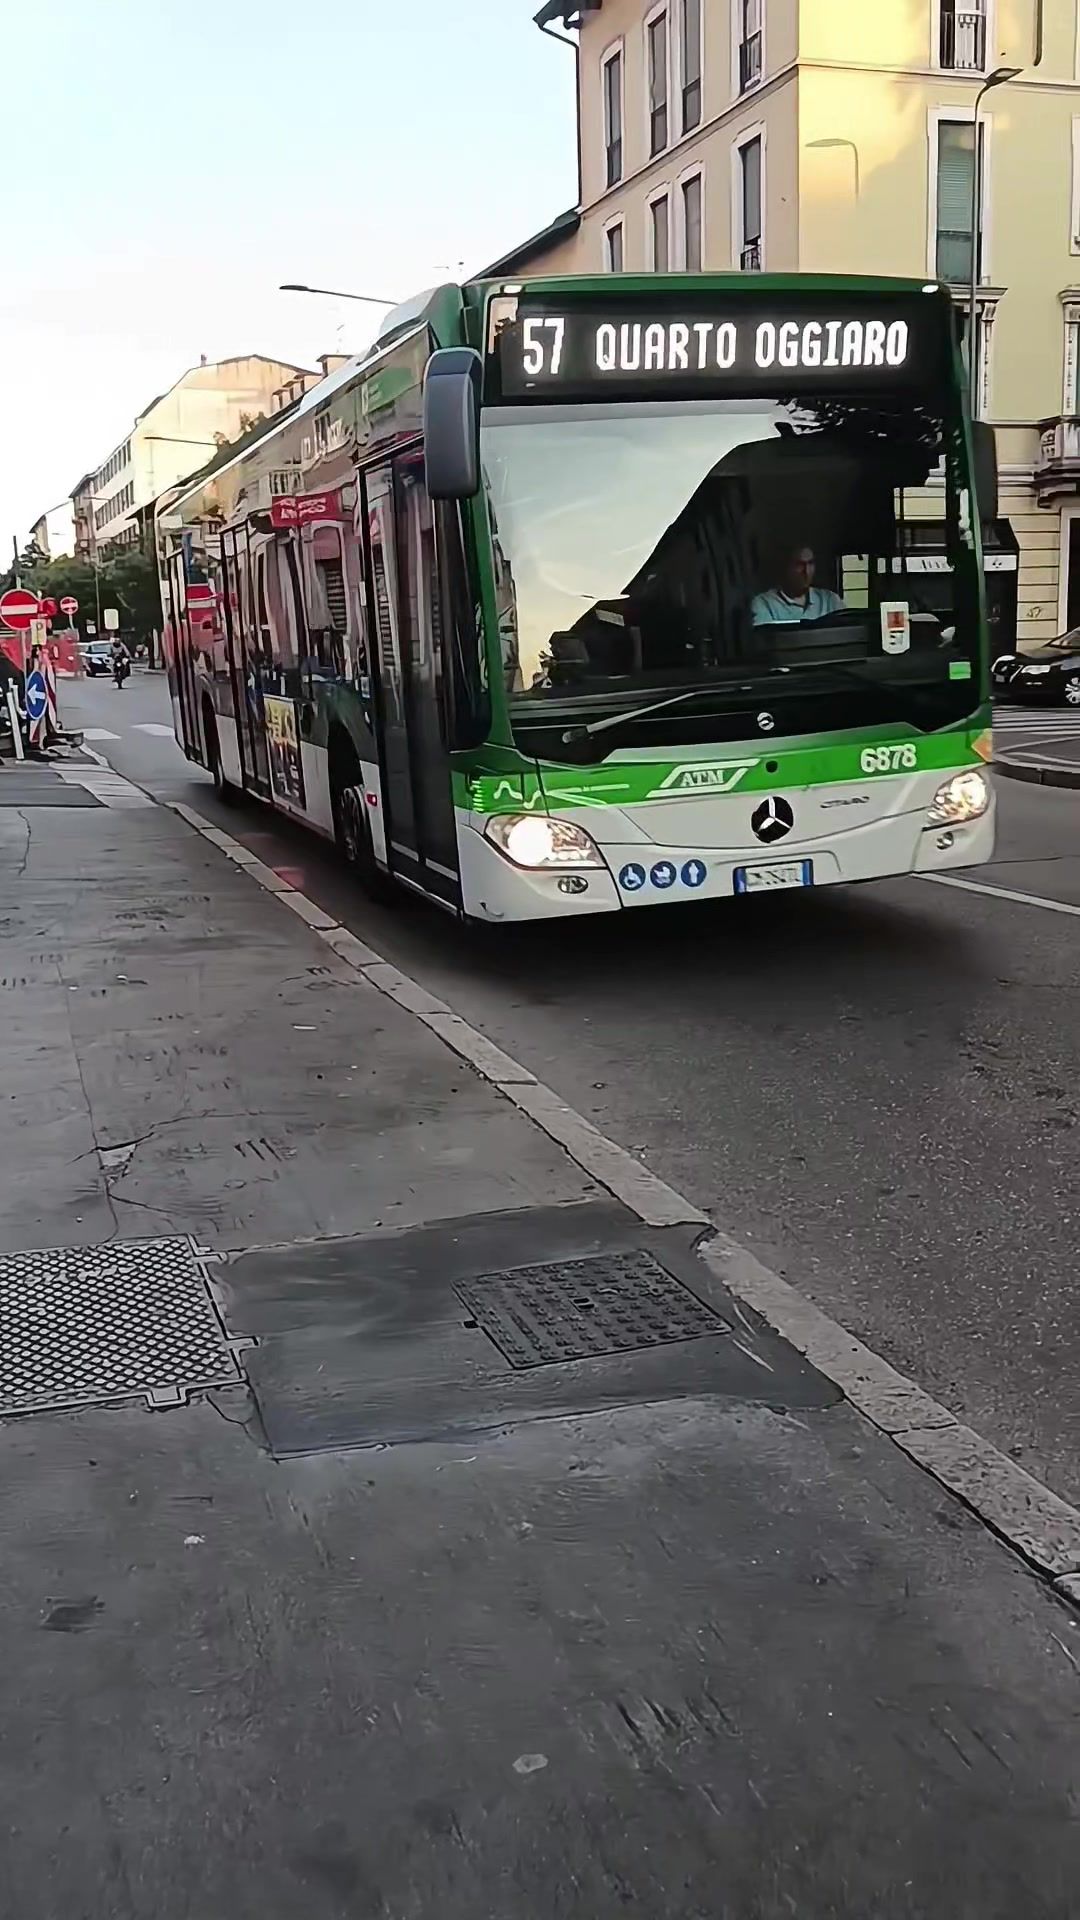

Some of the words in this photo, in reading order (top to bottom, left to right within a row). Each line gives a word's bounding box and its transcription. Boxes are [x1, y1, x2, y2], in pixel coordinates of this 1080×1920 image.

[523, 317, 565, 375] 57
[596, 322, 738, 371] QUARTO
[755, 320, 909, 368] OGGIARO
[860, 743, 917, 773] 6878
[679, 768, 725, 788] ATM
